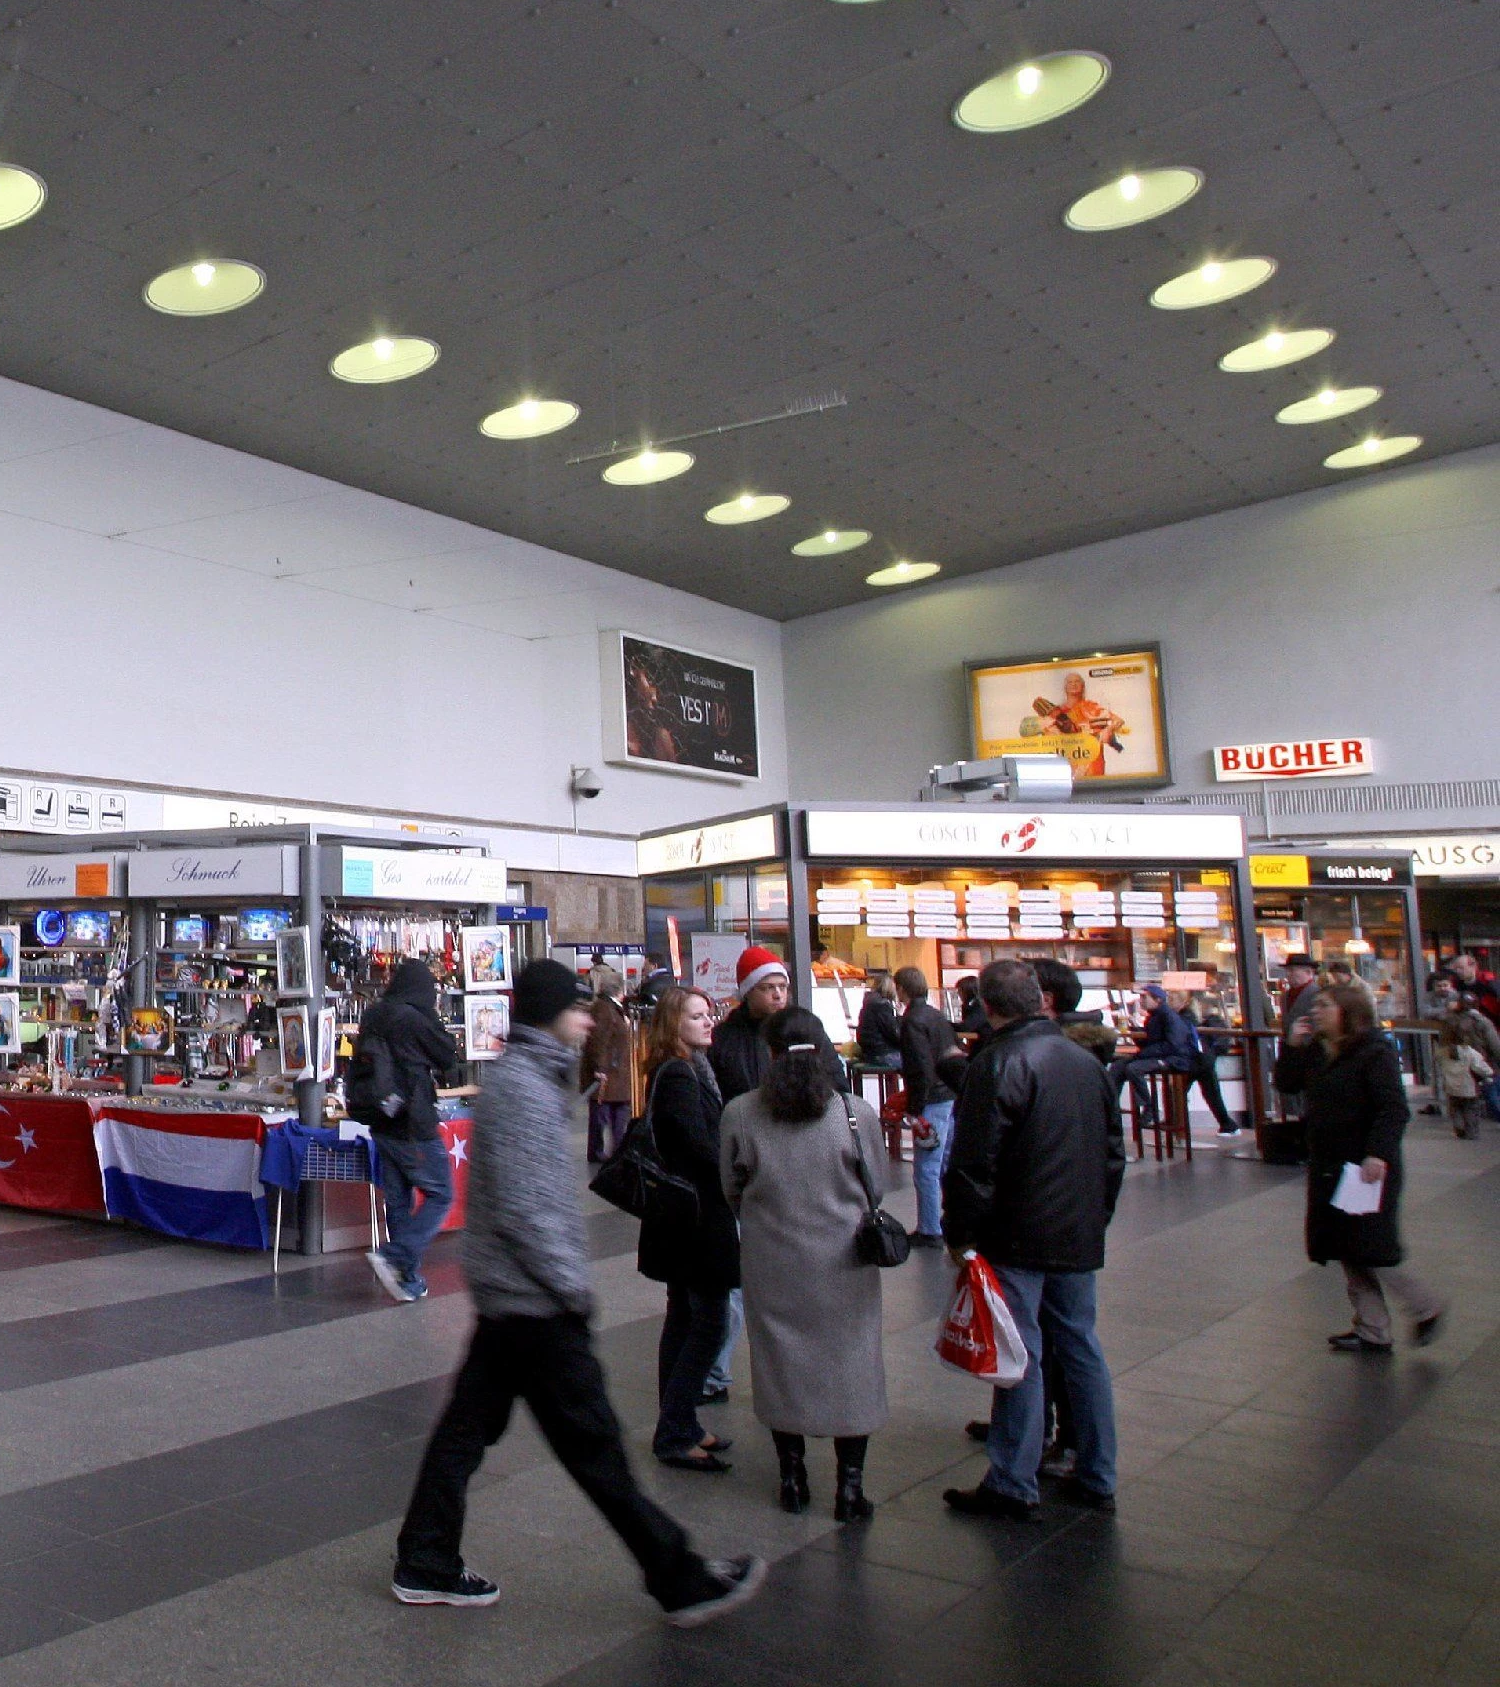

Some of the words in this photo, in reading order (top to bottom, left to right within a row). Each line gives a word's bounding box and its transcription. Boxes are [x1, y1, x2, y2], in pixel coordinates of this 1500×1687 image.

[680, 696, 702, 724] YES
[1221, 739, 1366, 771] BÜCHER
[37, 790, 43, 800] R
[76, 794, 81, 804] R
[110, 798, 115, 807] R
[1410, 845, 1493, 865] AUSG
[26, 864, 67, 889] Uhren
[166, 858, 242, 883] Schmuck
[1327, 865, 1357, 879] frisch
[1358, 866, 1392, 882] belegt
